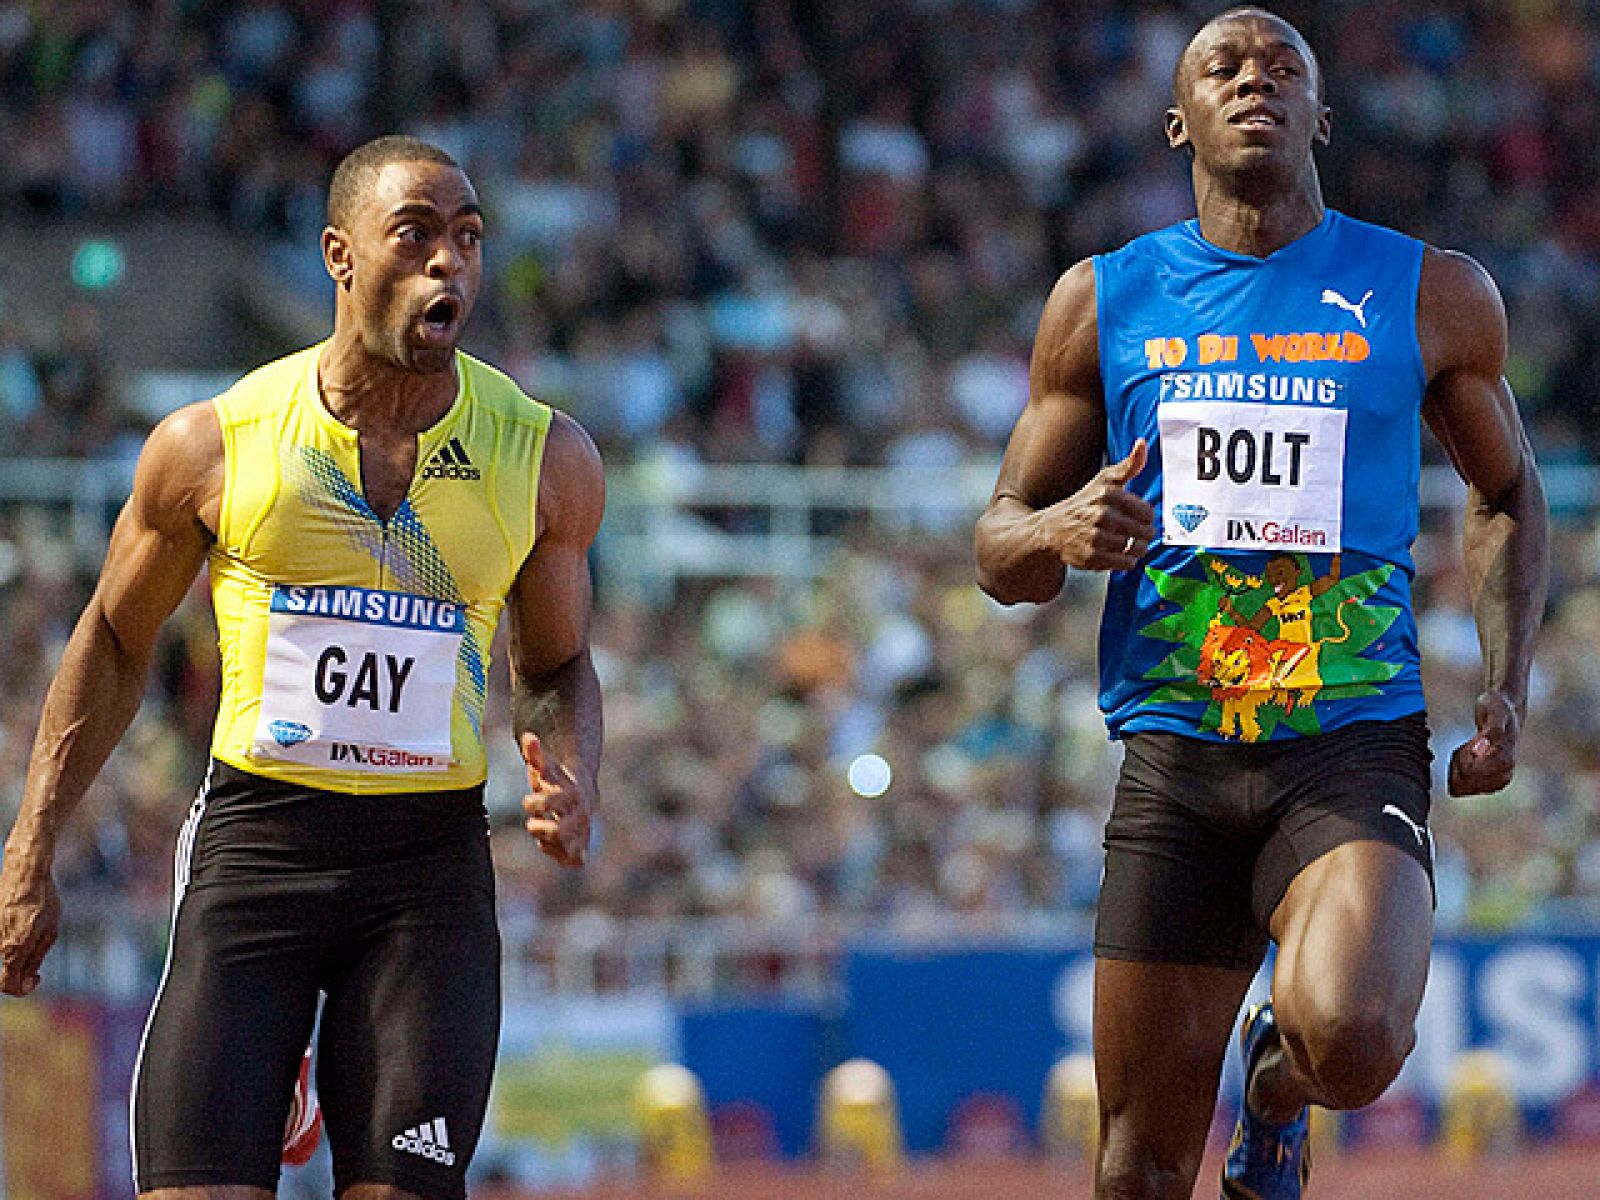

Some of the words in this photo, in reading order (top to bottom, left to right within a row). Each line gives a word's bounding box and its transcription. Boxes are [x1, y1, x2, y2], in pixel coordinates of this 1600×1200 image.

[1145, 336, 1188, 369] TO
[1197, 334, 1239, 365] DI
[1250, 330, 1370, 364] WORLD
[1174, 372, 1336, 403] SAMSUNG
[421, 462, 480, 481] adidas
[1197, 426, 1310, 487] BOLT
[287, 587, 456, 629] SAMSUNG
[315, 645, 415, 713] GAY
[391, 1133, 456, 1167] adidas
